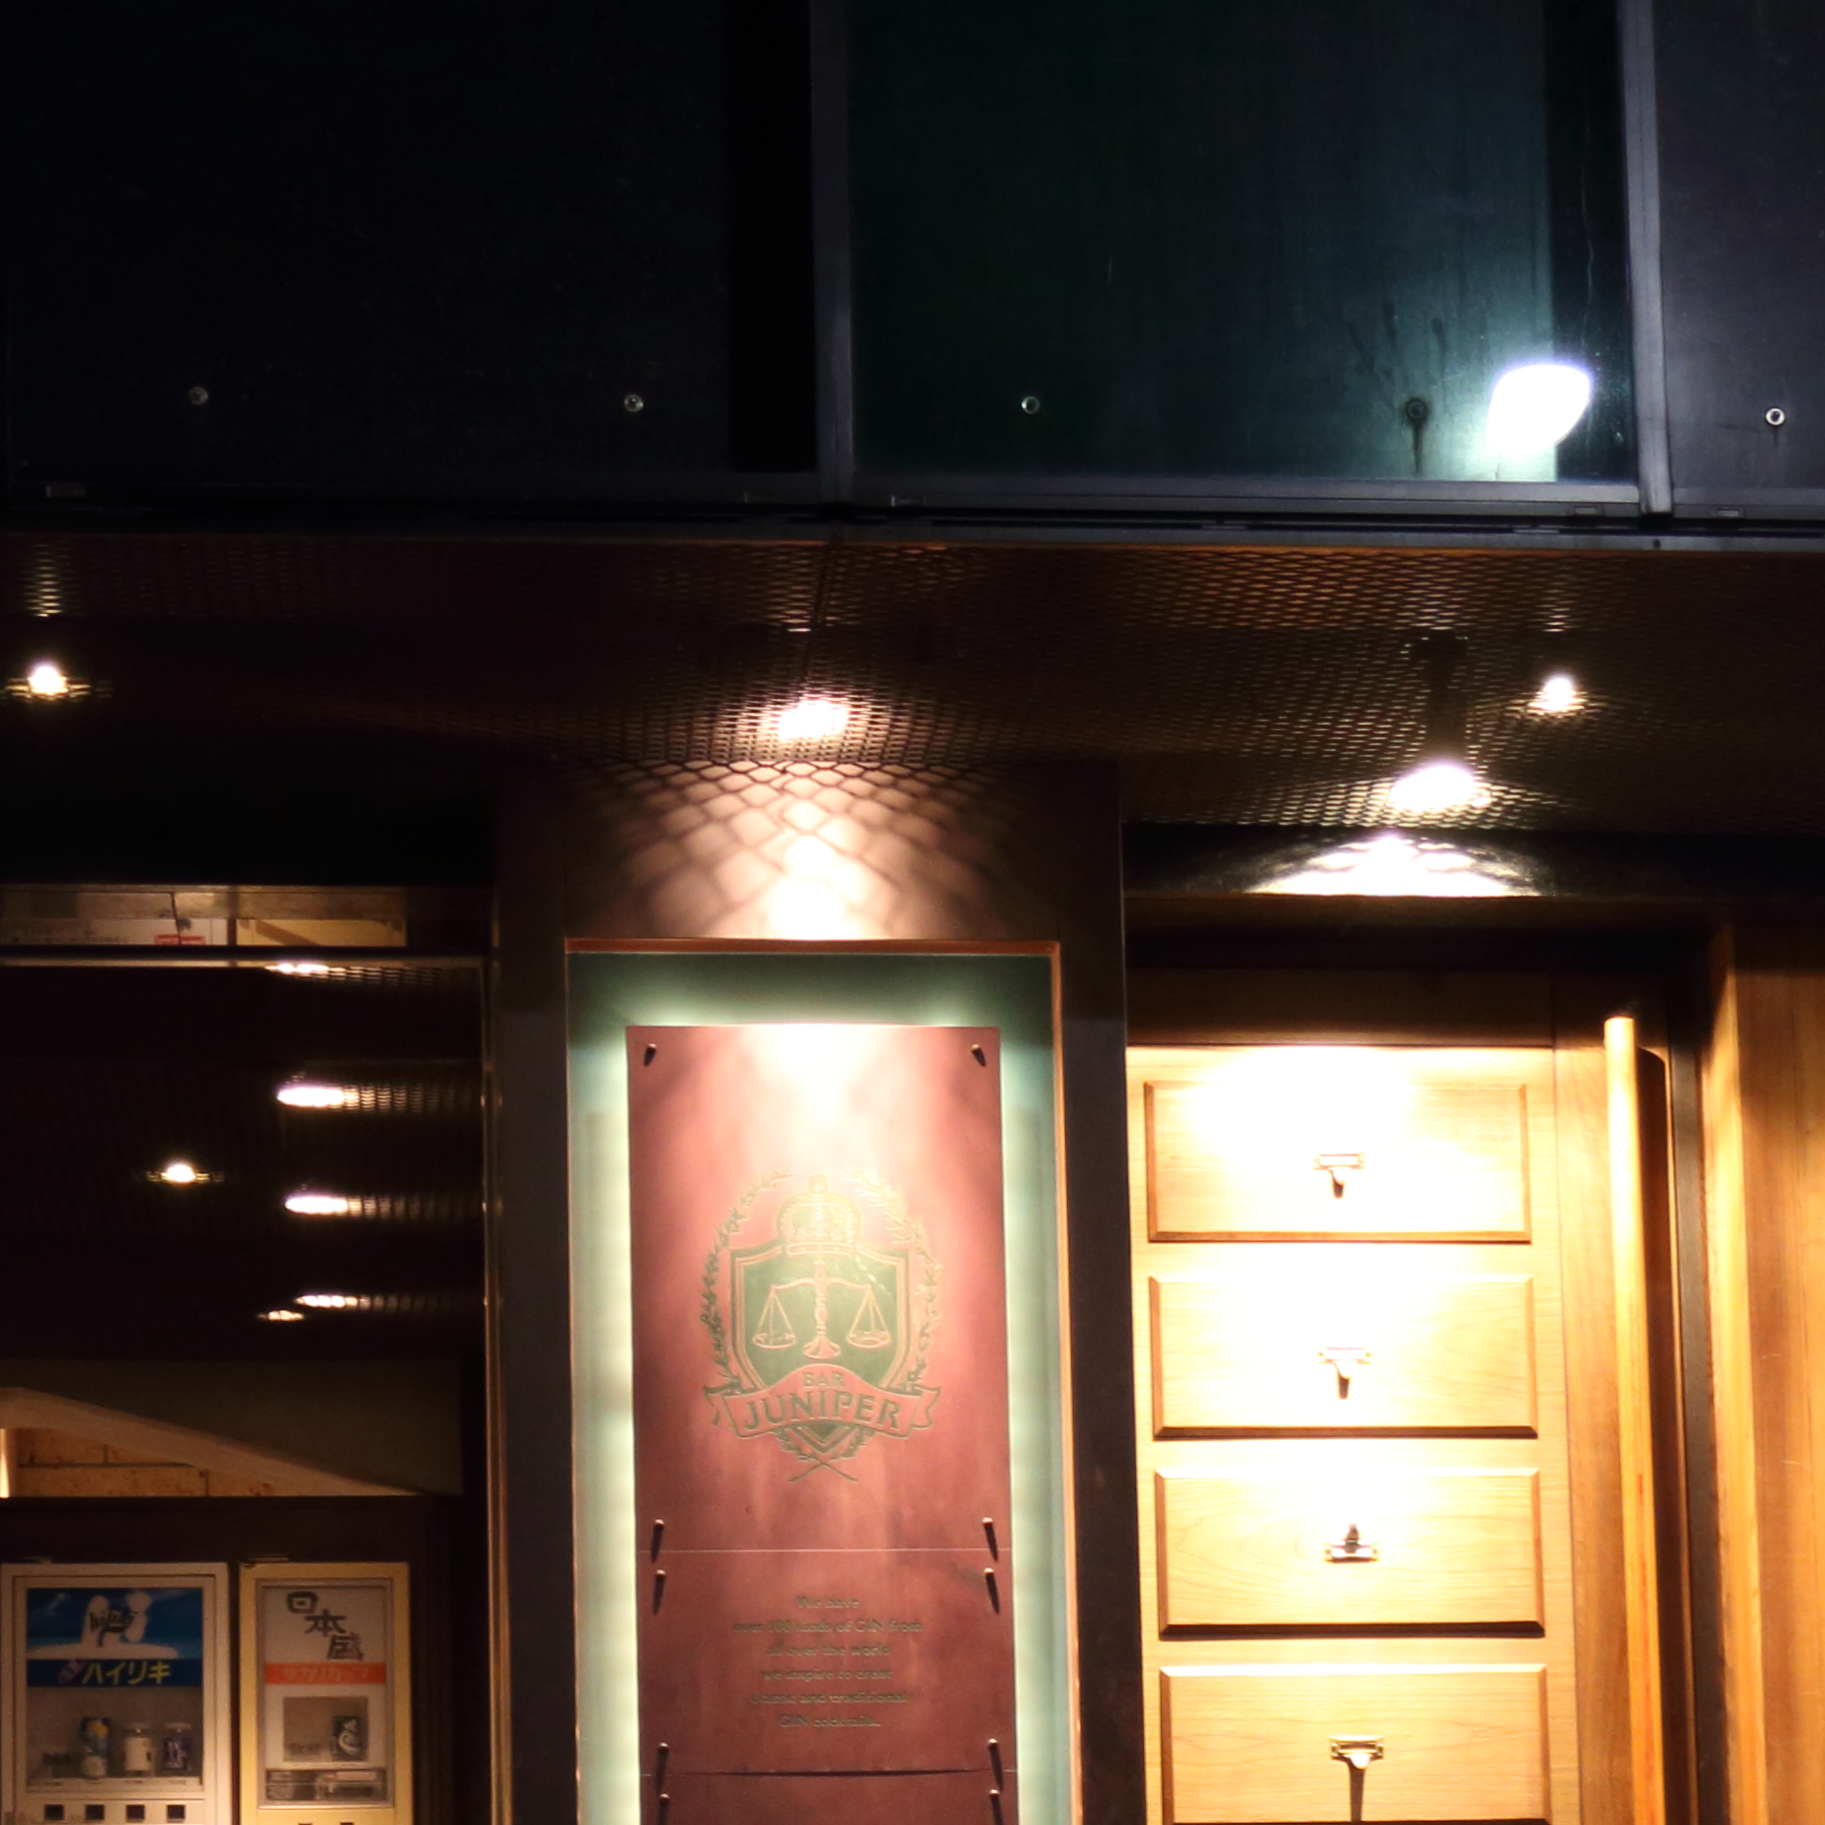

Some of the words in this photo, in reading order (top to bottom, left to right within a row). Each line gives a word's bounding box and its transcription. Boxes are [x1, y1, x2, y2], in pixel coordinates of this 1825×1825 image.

[802, 1371, 845, 1390] BAR
[744, 1390, 901, 1431] JUNIPER
[82, 1660, 171, 1685] ハイリキ
